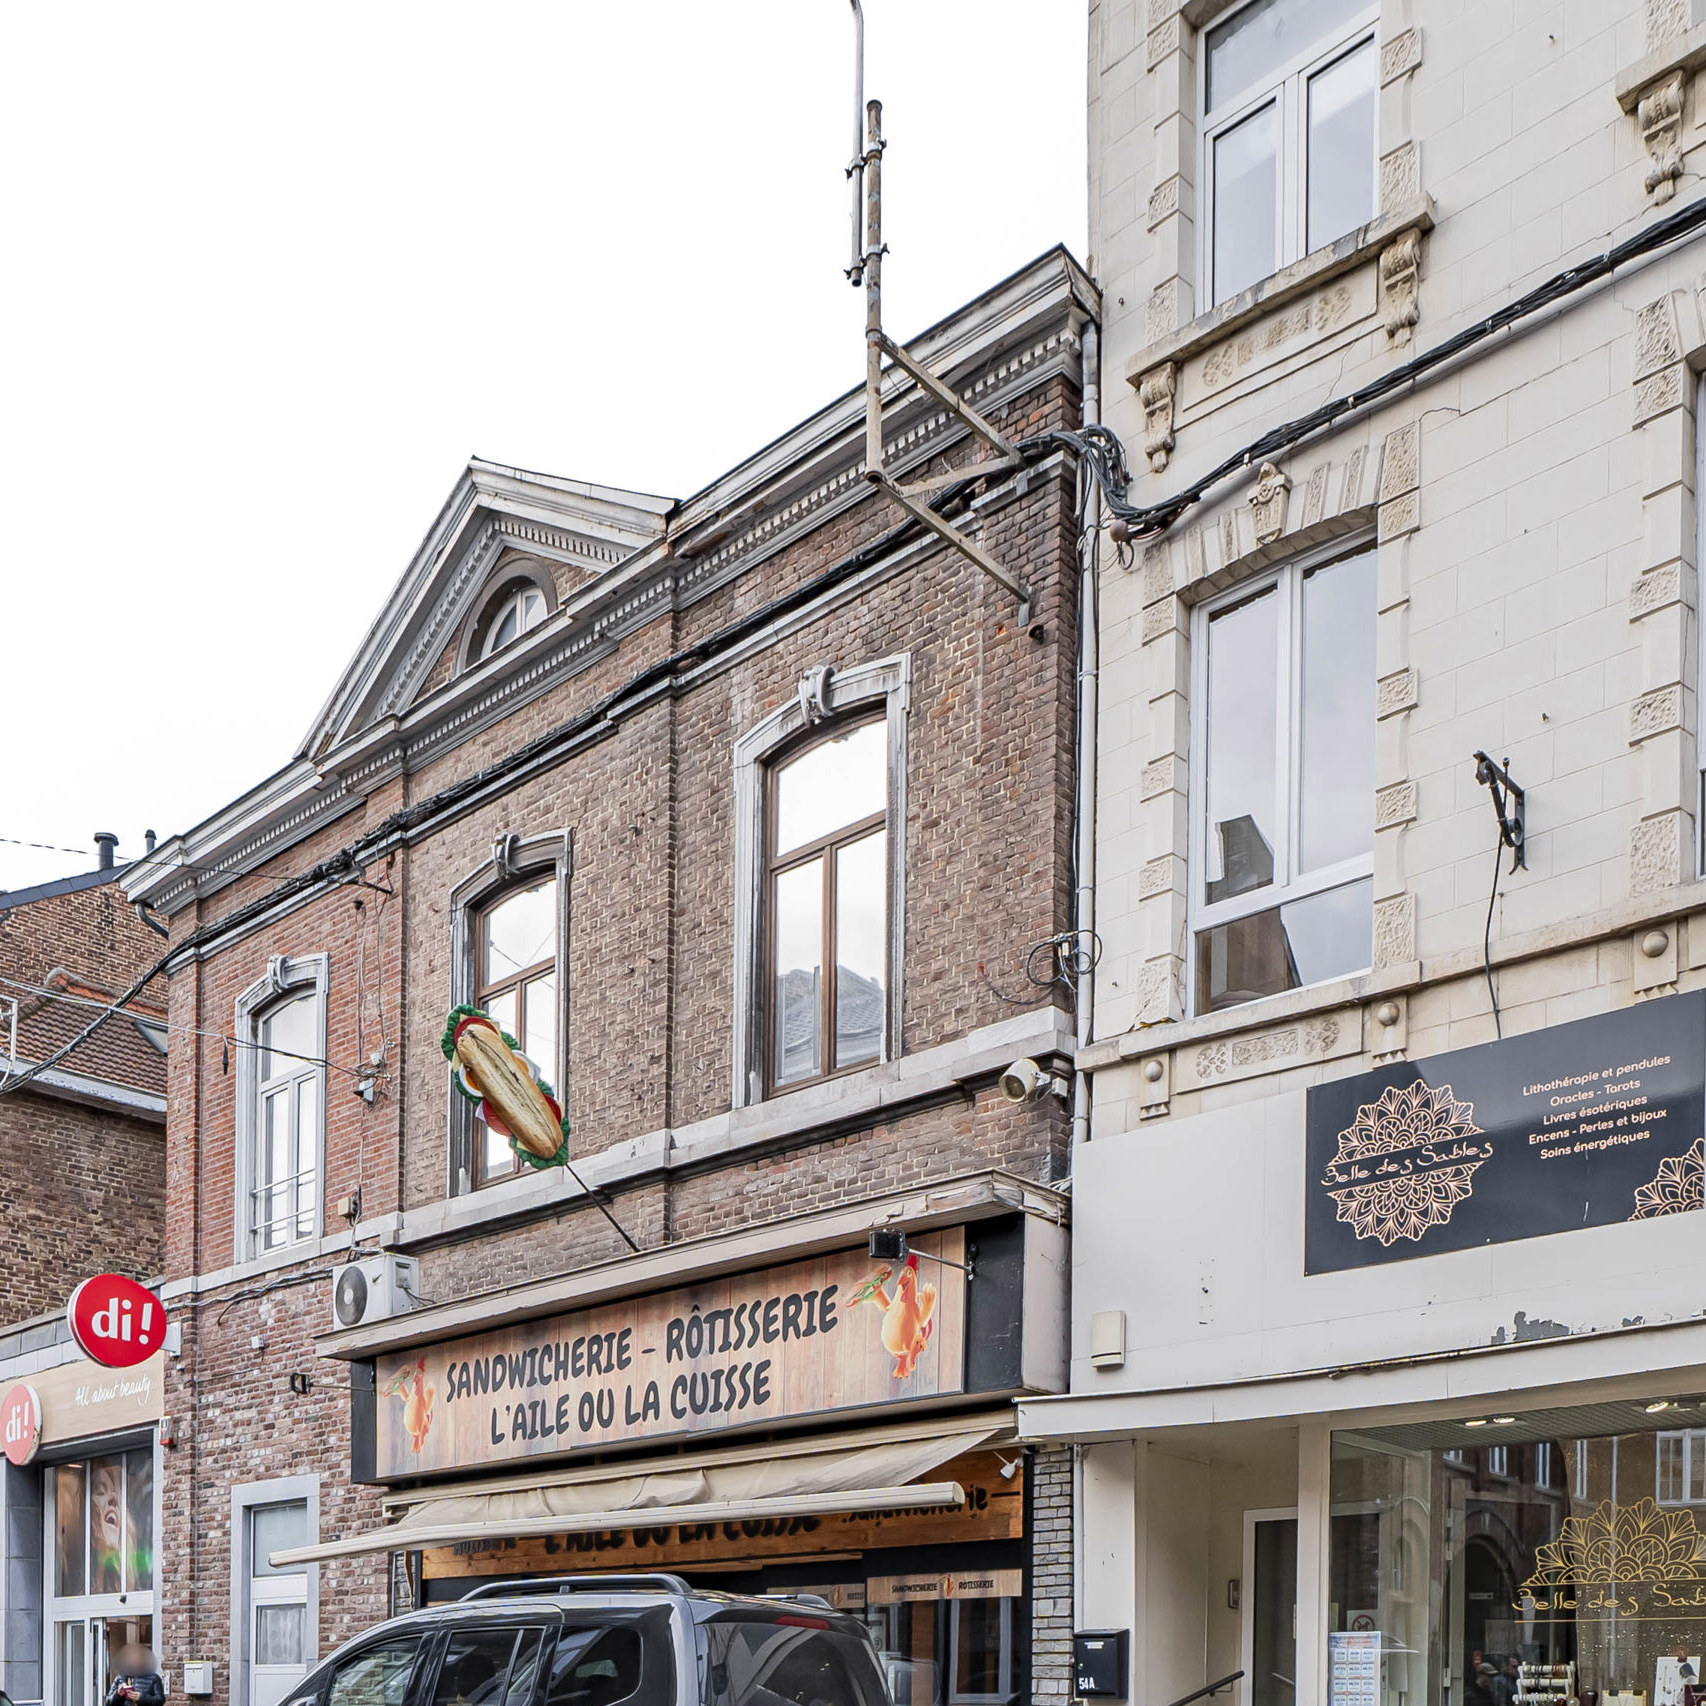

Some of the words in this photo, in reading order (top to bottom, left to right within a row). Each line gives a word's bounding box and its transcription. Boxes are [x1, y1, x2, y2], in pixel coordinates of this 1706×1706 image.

[1523, 1072, 1599, 1096] Lithothérapie
[1601, 1068, 1613, 1079] et
[1616, 1055, 1671, 1077] pendules
[1550, 1090, 1594, 1107] Oracles
[1604, 1079, 1641, 1095] Tarots
[1528, 1129, 1570, 1145] Encens
[1579, 1120, 1614, 1134] Perles
[1616, 1116, 1629, 1127] et
[1631, 1108, 1668, 1124] bijoux
[1543, 1111, 1577, 1126] Livres
[1579, 1095, 1648, 1117] ésotériques
[1320, 1165, 1372, 1186] Belle
[1375, 1159, 1413, 1175] des
[1417, 1141, 1494, 1166] Sables
[1540, 1146, 1572, 1160] Soins
[1573, 1130, 1651, 1153] énergétiques
[91, 1297, 153, 1345] di!
[446, 1326, 632, 1403] SANDWICHERIE
[666, 1284, 839, 1364] RÔTISSERIE
[75, 1384, 91, 1407] All
[92, 1379, 119, 1403] about
[119, 1373, 151, 1407] beauty
[491, 1393, 570, 1446] L'AILE
[578, 1388, 614, 1433] OU
[624, 1380, 661, 1427] LA
[670, 1359, 772, 1420] CUISSE
[5, 1401, 30, 1444] di!
[1511, 1588, 1580, 1611] Belle
[1587, 1589, 1639, 1616] des
[1078, 1676, 1096, 1690] 54A
